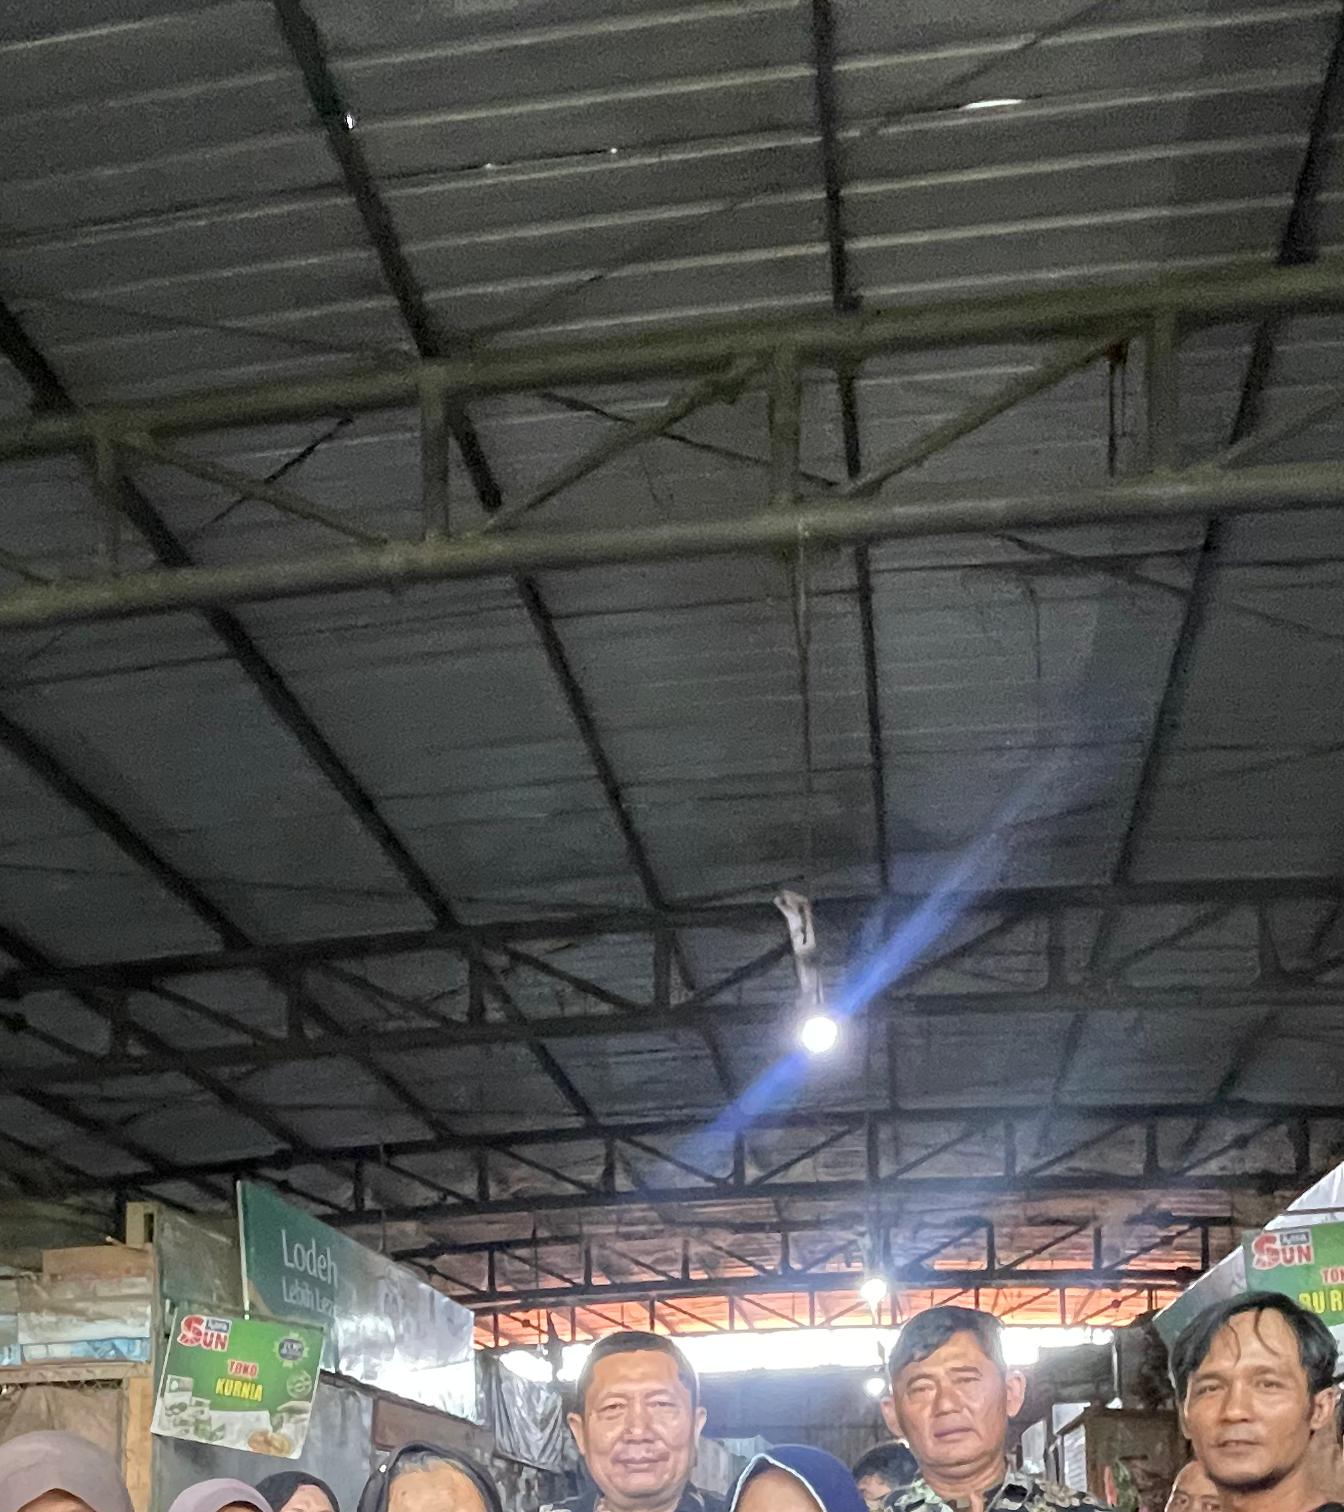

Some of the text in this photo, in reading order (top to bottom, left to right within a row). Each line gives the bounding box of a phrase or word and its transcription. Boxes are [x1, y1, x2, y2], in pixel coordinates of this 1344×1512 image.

[281, 1228, 338, 1289] Lodeh
[228, 1360, 258, 1378] TOKO
[216, 1377, 264, 1402] KURNIA
